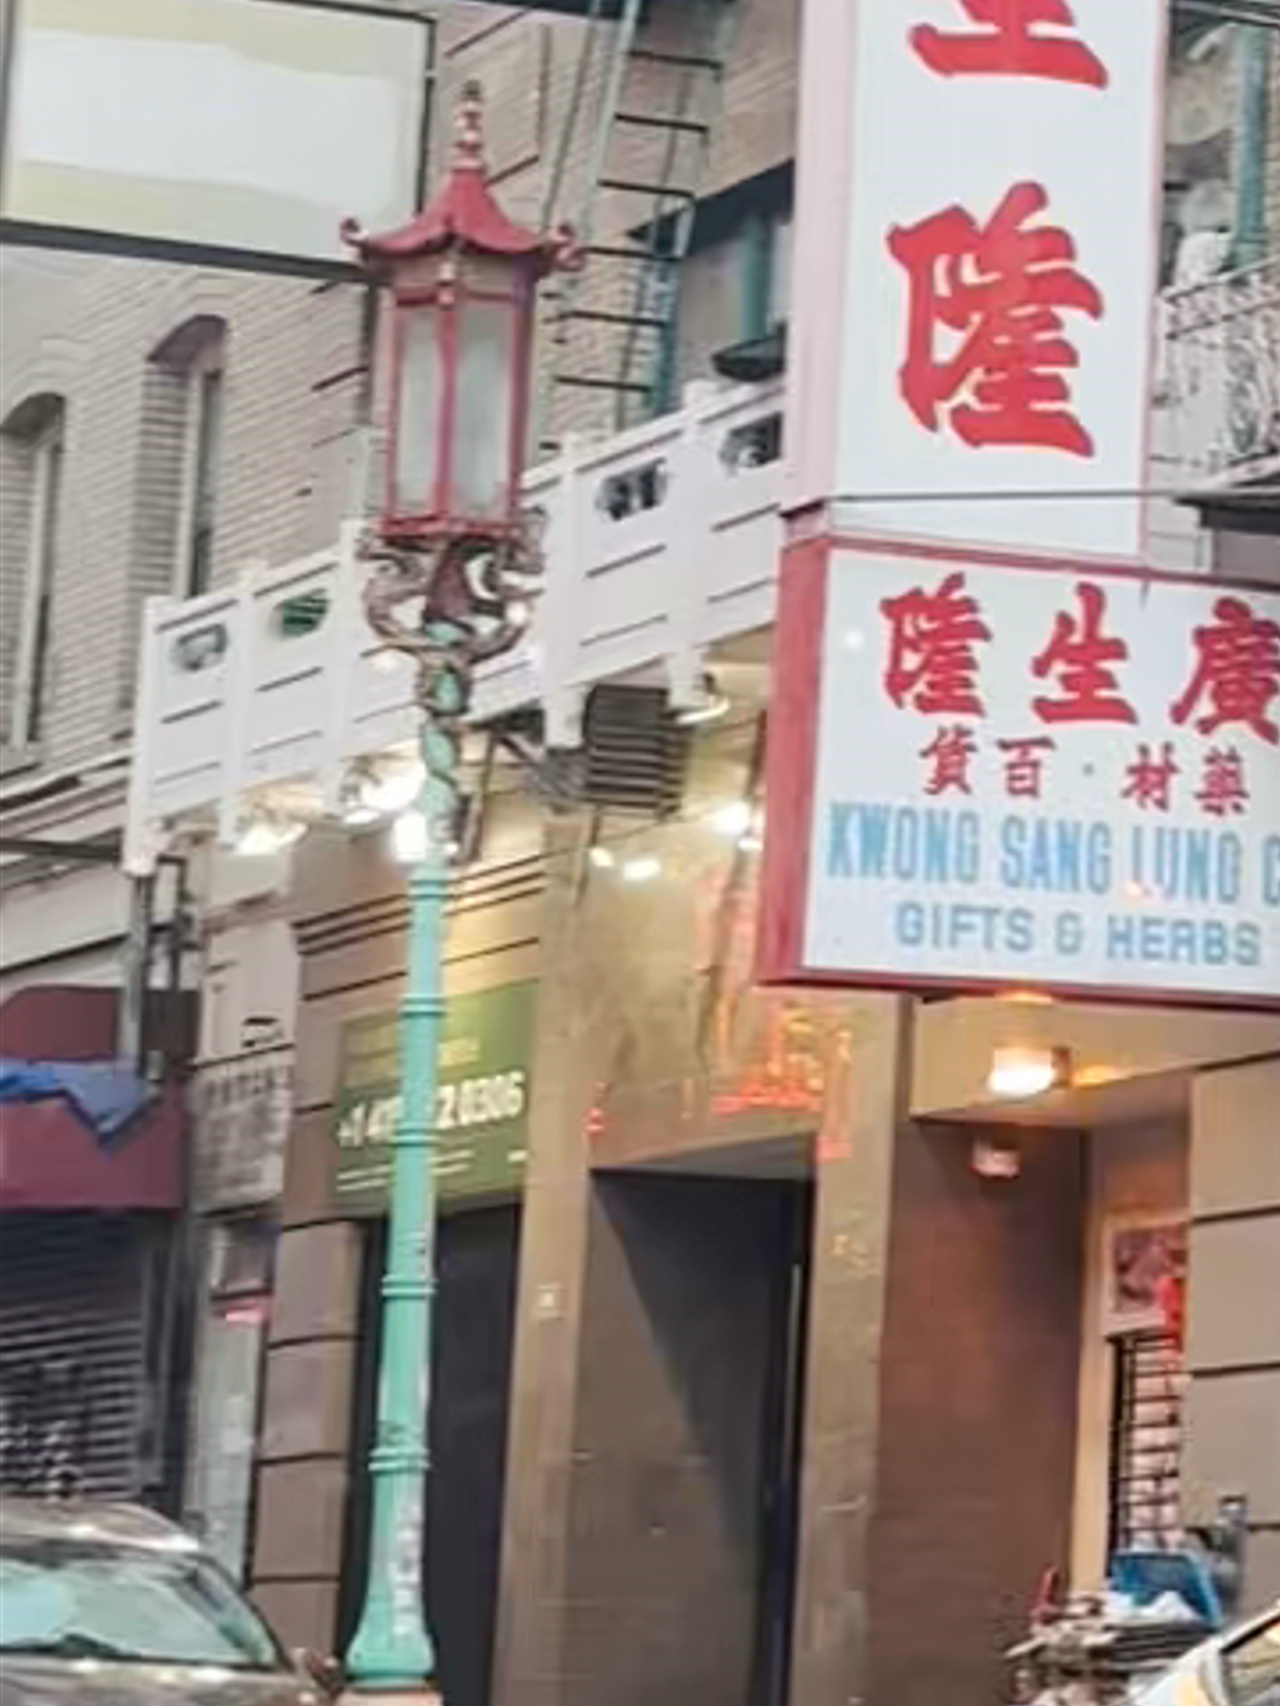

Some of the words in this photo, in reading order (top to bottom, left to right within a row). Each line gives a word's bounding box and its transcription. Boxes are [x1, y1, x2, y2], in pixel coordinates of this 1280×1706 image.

[827, 801, 980, 884] KWONG
[1000, 815, 1112, 895] SANG
[1132, 824, 1242, 905] LUNG
[896, 903, 1034, 953] GIFTS
[1055, 912, 1082, 957] &
[1107, 914, 1262, 967] HERBS
